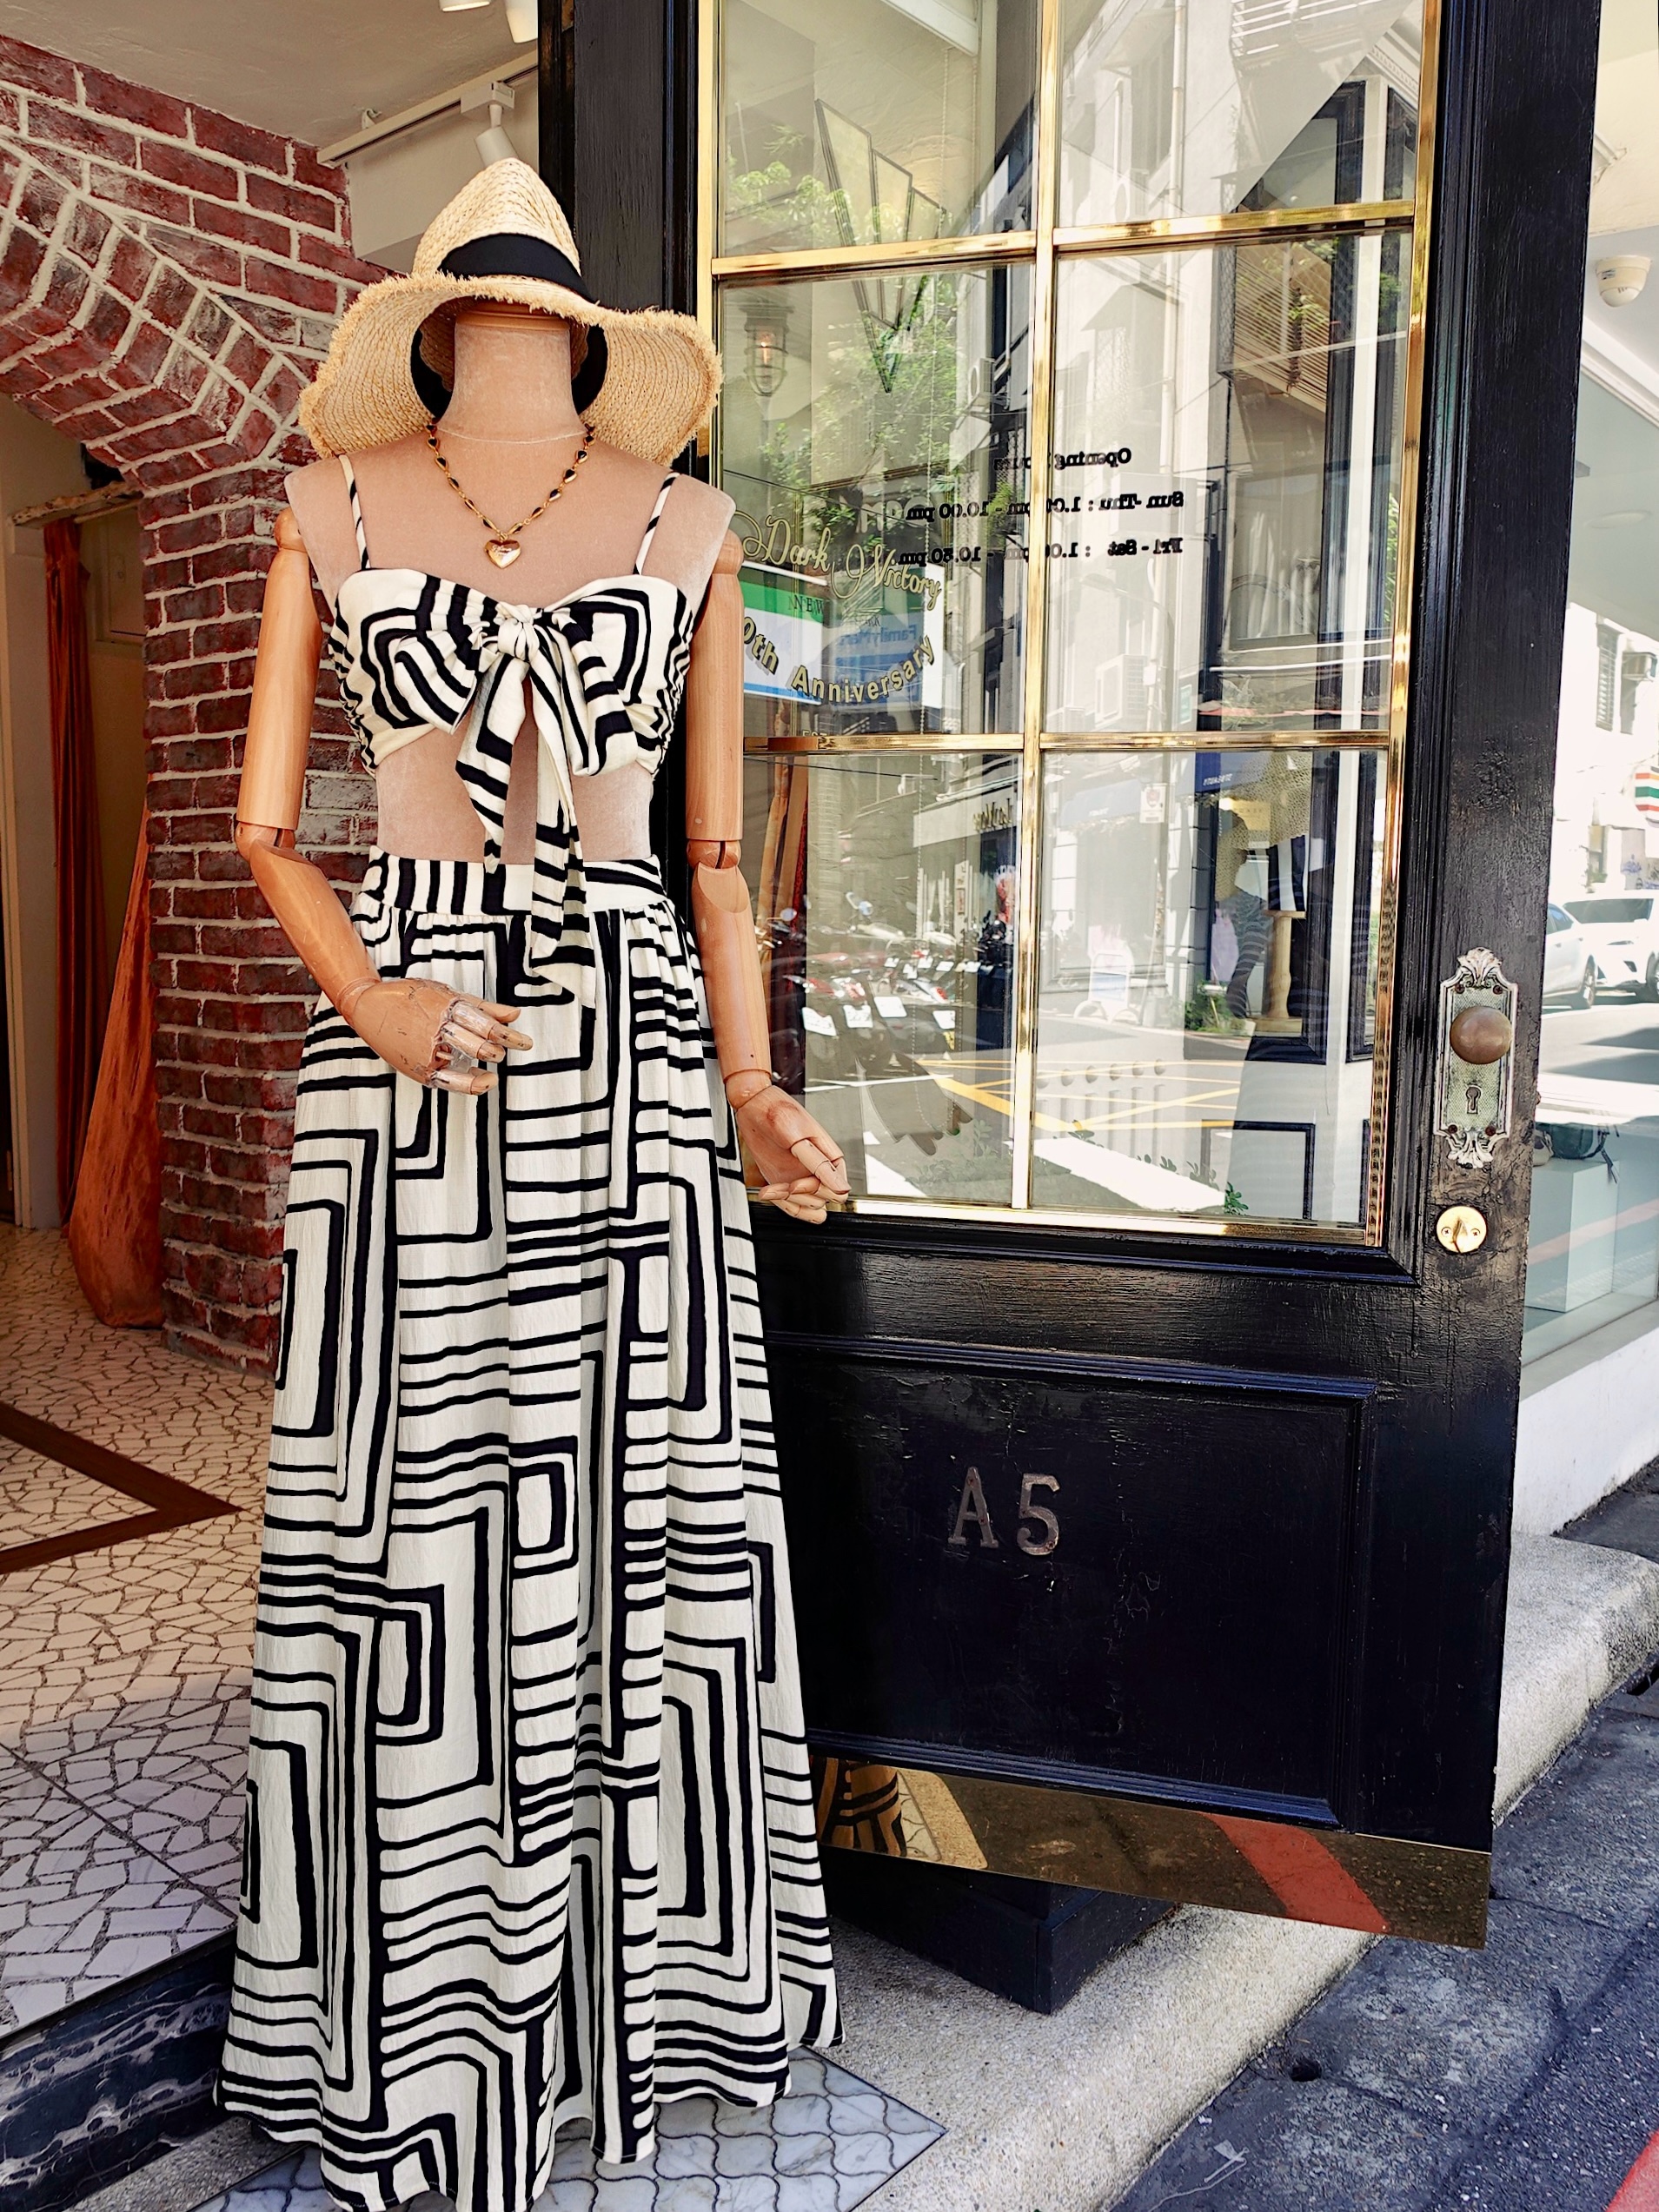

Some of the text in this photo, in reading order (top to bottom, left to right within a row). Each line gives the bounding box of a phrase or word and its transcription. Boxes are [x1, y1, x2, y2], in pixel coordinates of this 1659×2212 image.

[735, 509, 832, 572] Dark
[831, 544, 942, 611] Victory
[791, 634, 935, 704] Anniversary
